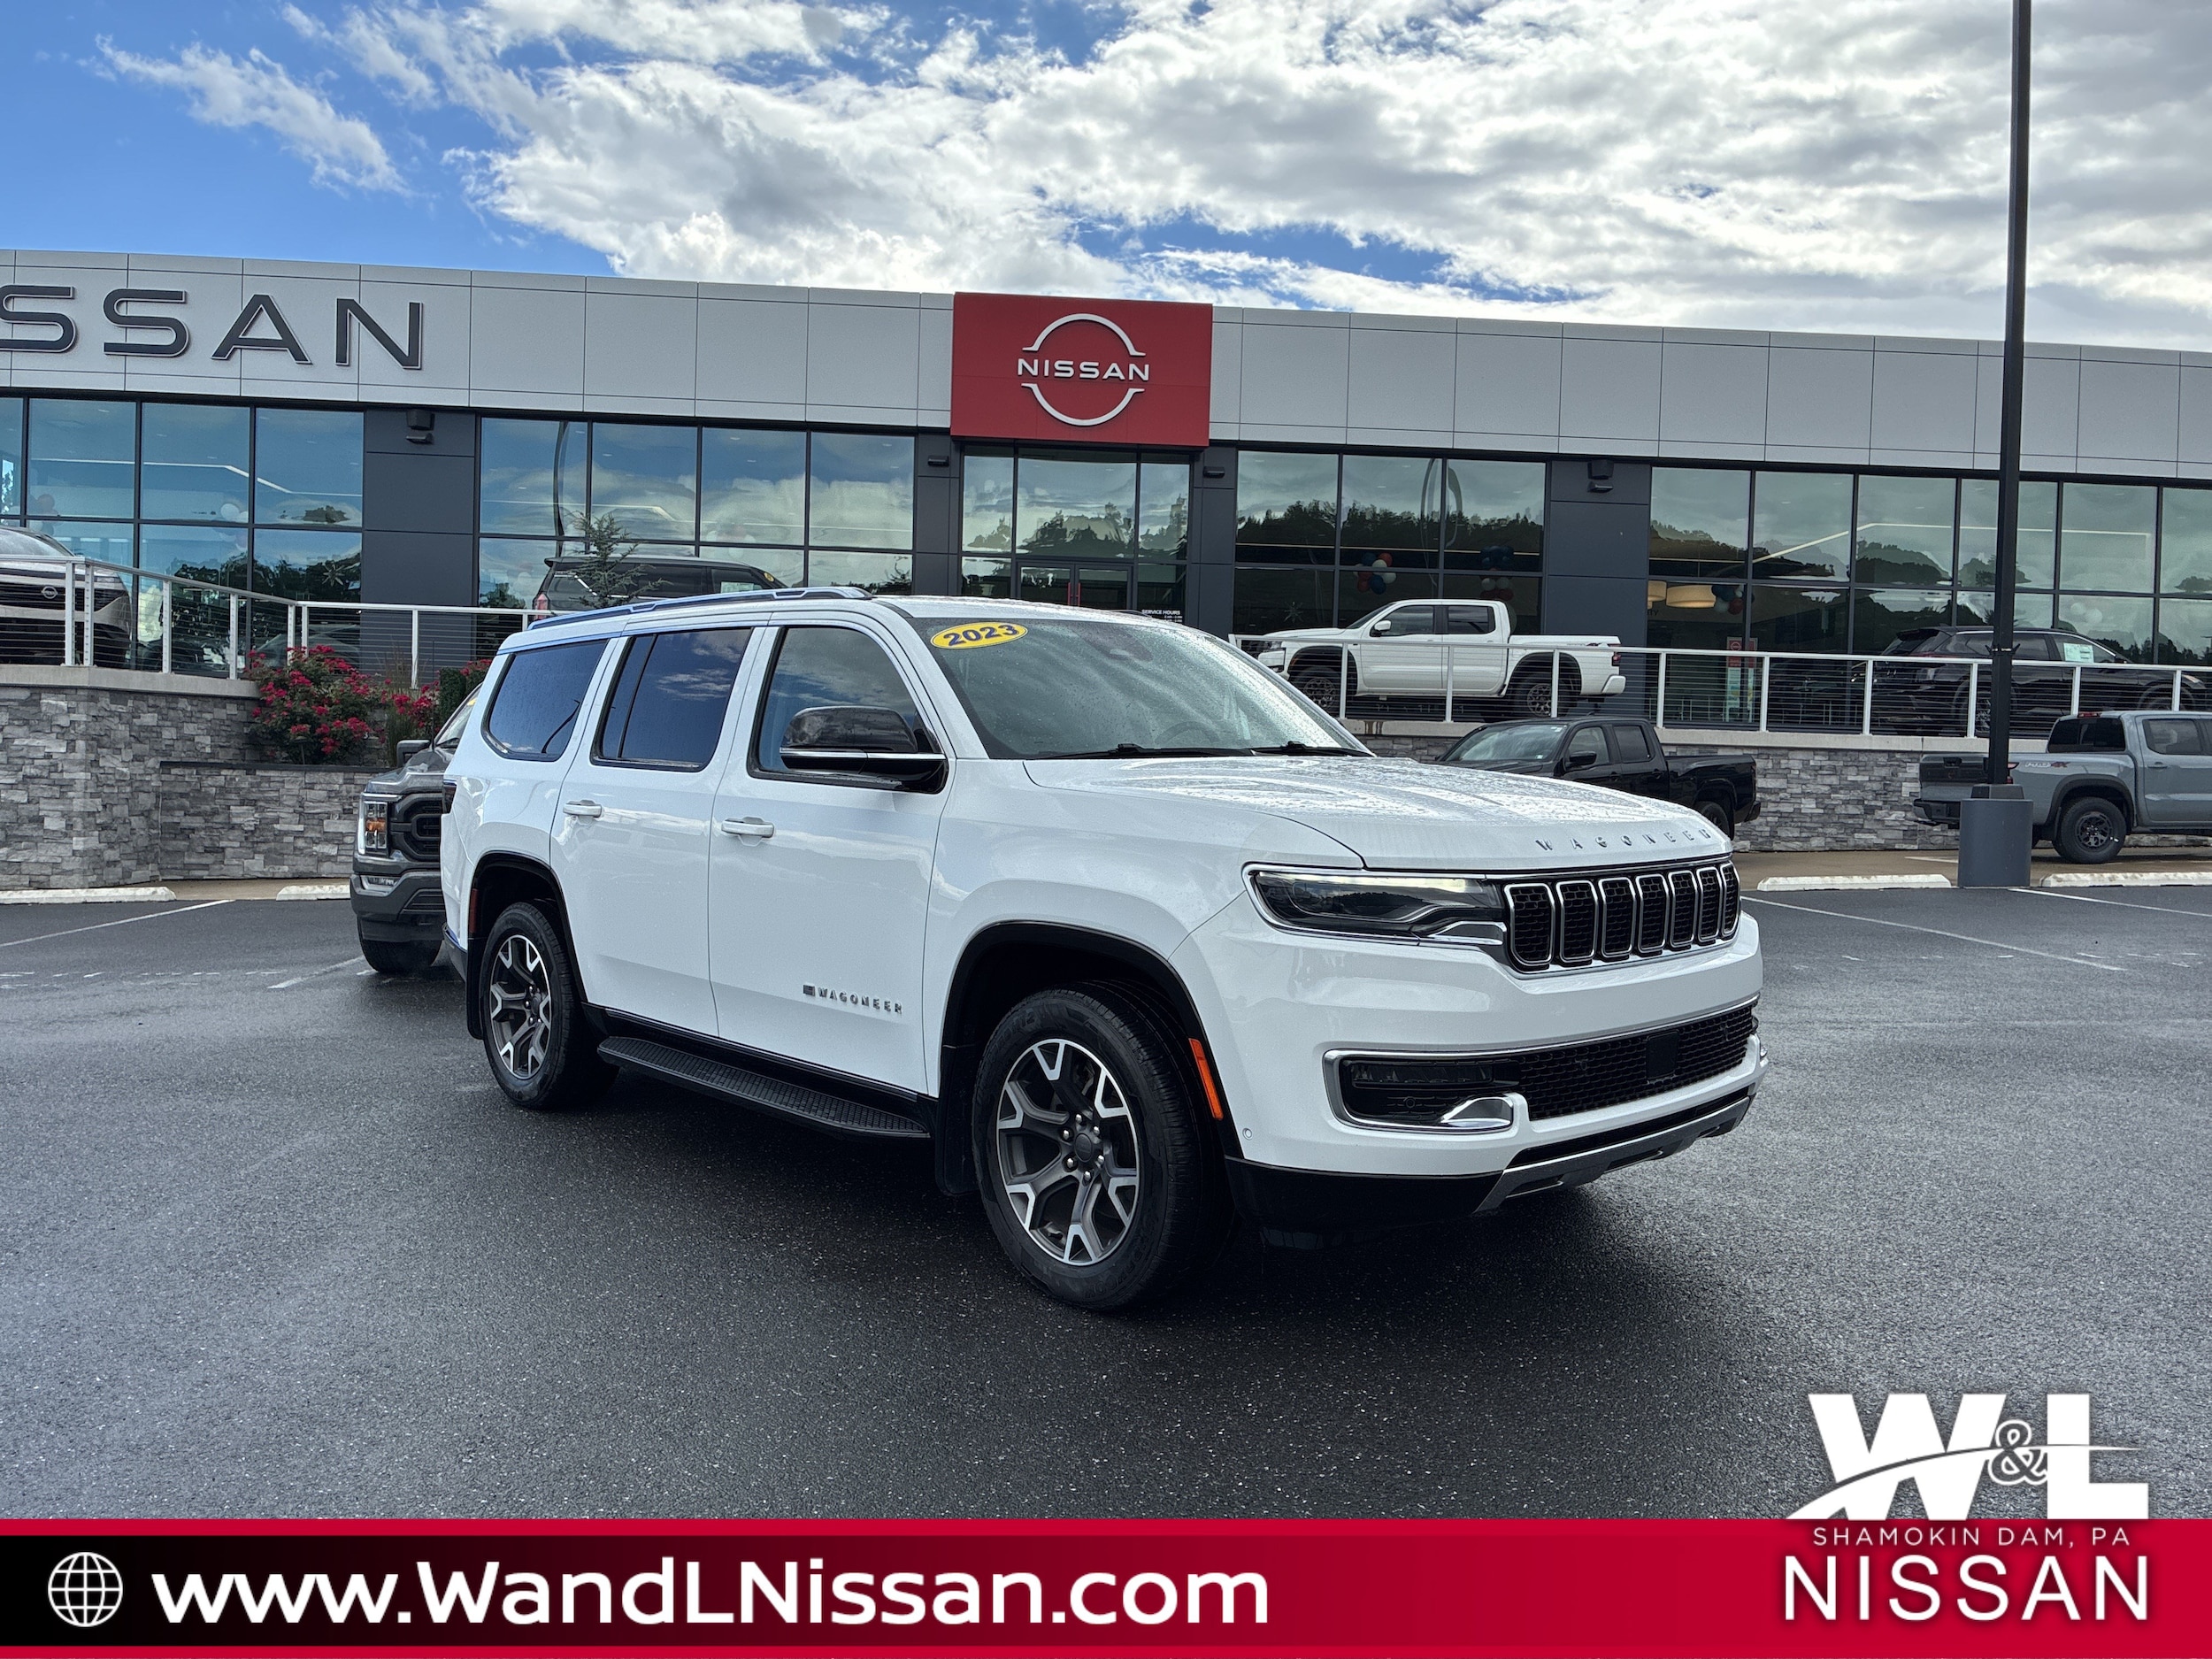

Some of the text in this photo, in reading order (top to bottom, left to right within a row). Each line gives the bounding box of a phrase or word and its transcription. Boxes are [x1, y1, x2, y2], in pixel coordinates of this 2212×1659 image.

[1018, 358, 1149, 381] NISSAN
[943, 625, 1019, 646] 2023
[1535, 828, 1711, 851] WAGONEER
[818, 987, 902, 1014] WAGONEER
